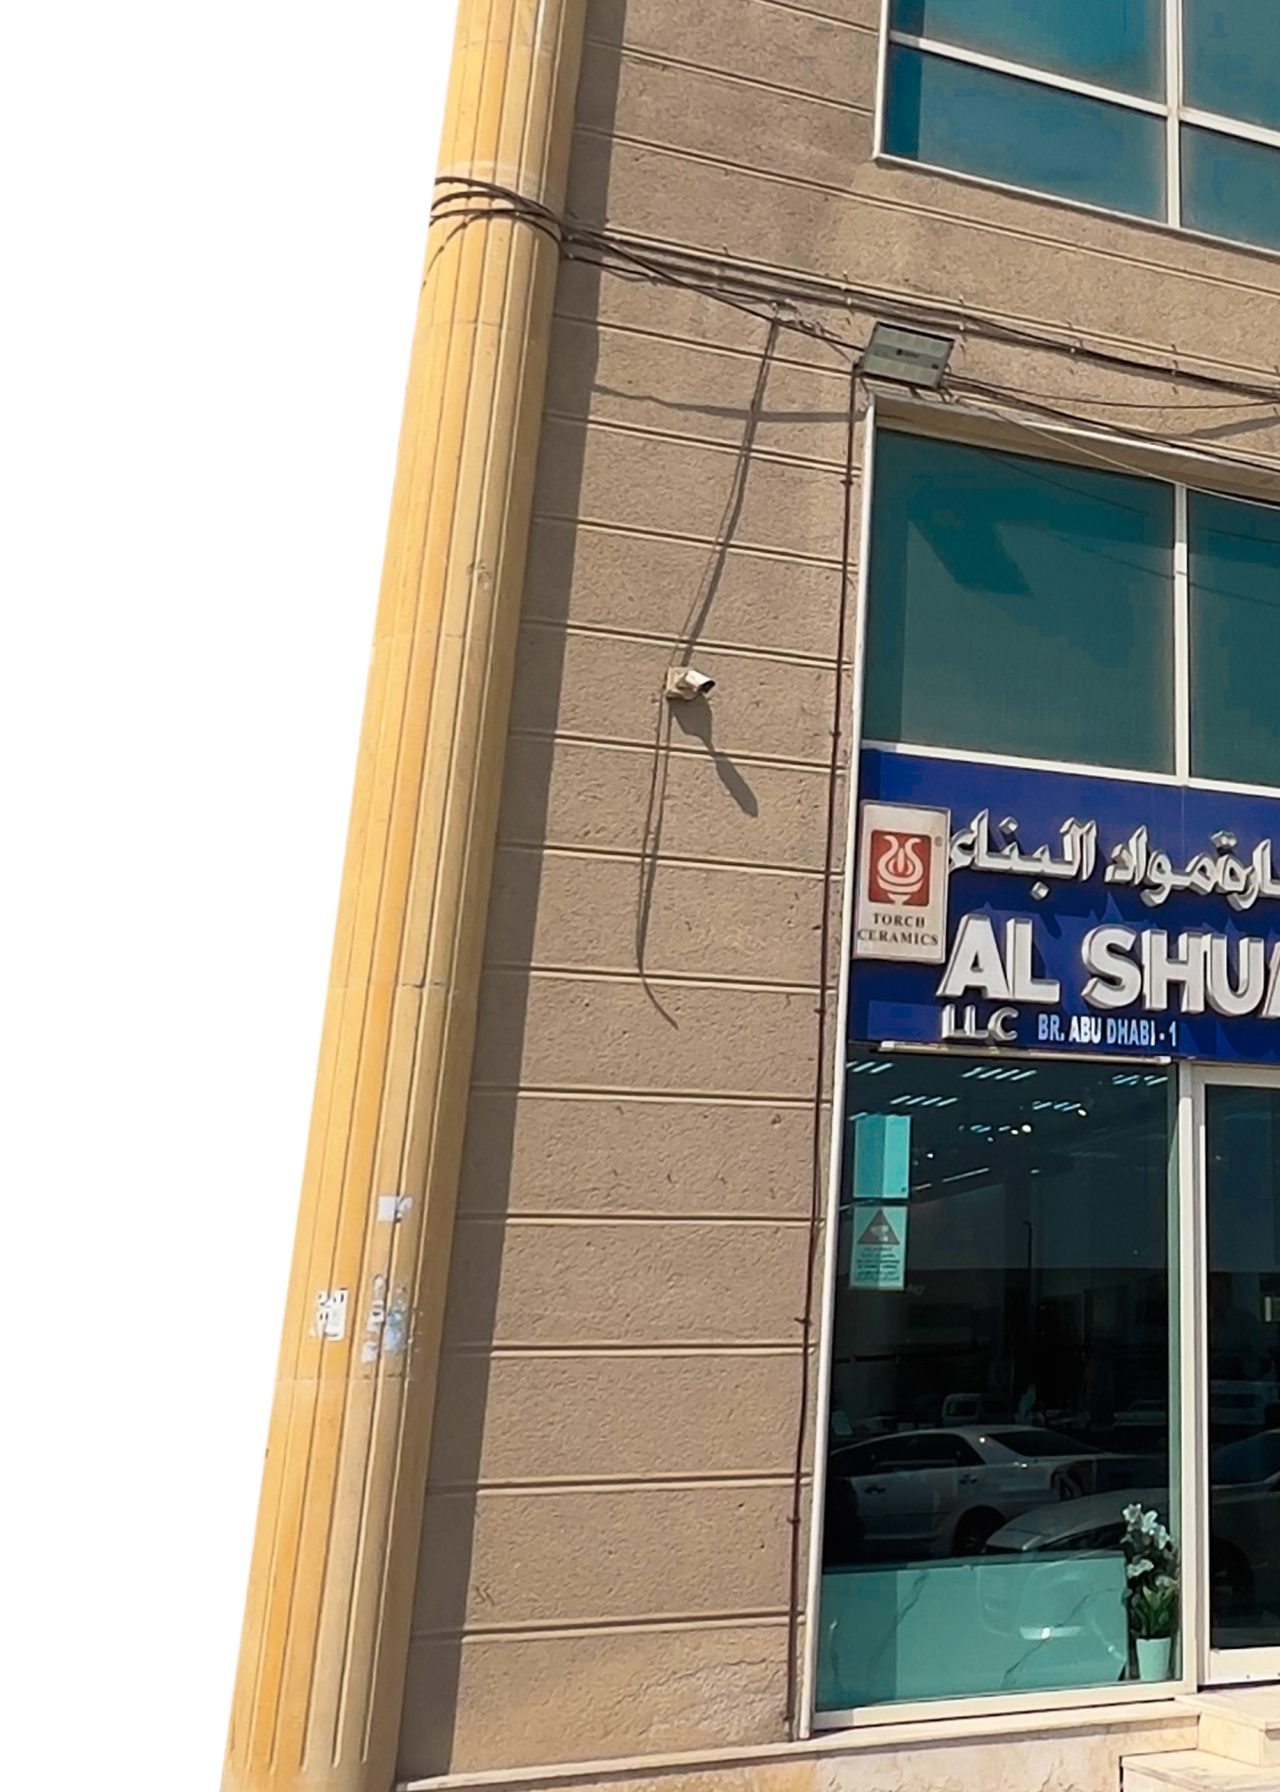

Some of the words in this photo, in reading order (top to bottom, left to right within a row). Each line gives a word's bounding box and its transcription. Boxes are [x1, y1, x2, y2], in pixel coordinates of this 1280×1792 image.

[949, 808, 1097, 900] البناء
[1104, 825, 1218, 907] مواد
[857, 928, 939, 946] CERAMICS
[872, 912, 925, 928] TORCH
[936, 914, 1060, 1003] AL
[941, 1003, 1019, 1042] LLC
[1037, 1013, 1065, 1042] BR.
[1068, 1015, 1102, 1045] ABU
[1106, 1017, 1156, 1047] DHABI
